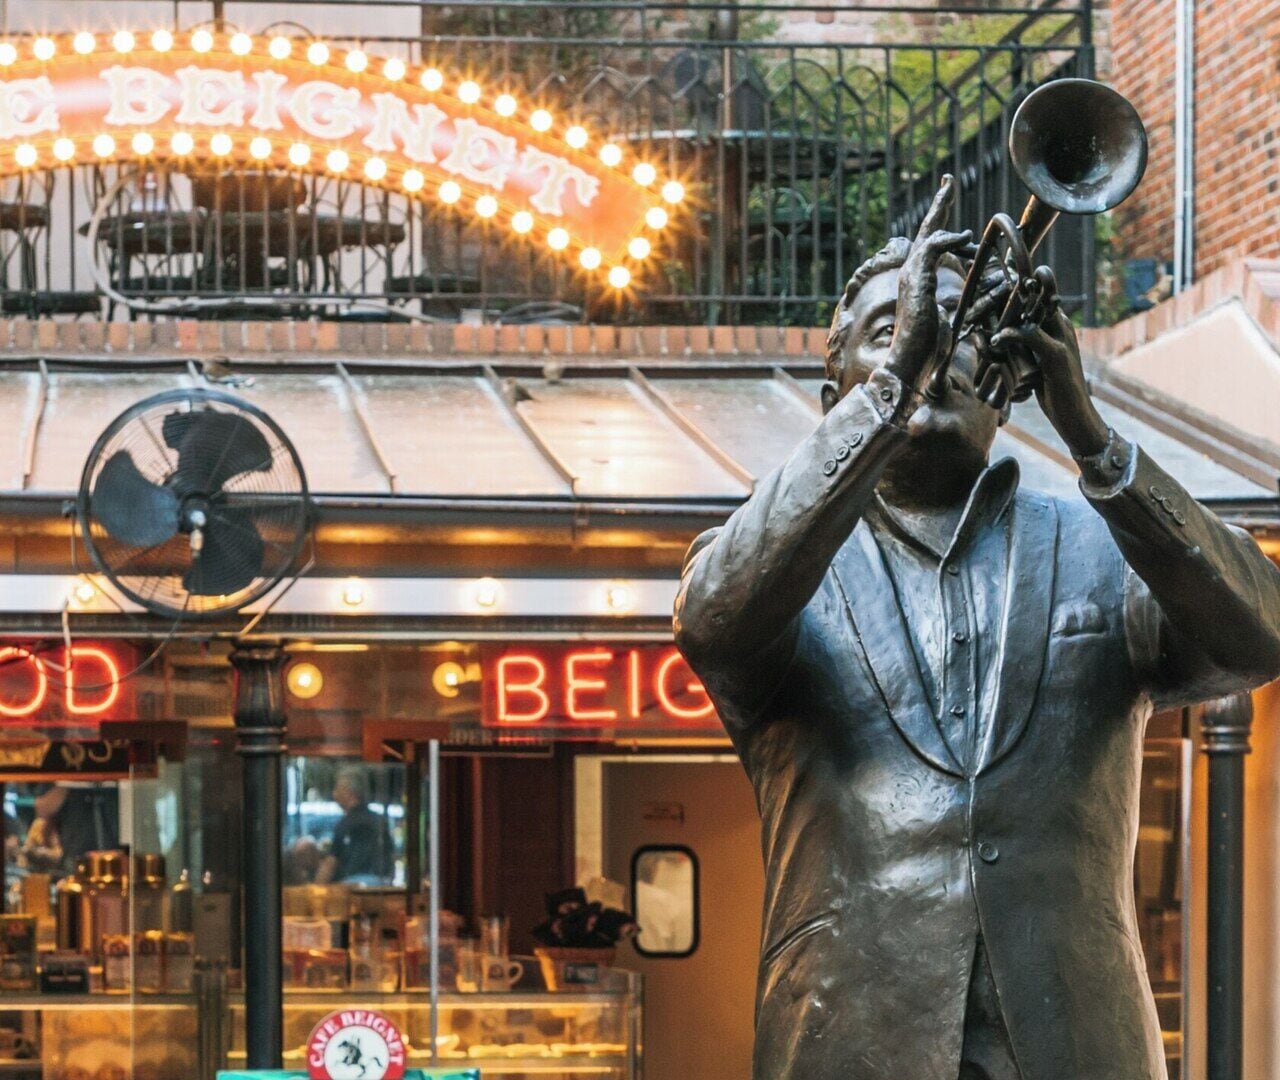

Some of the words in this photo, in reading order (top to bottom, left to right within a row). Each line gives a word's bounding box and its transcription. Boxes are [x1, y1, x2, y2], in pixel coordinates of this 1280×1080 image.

[98, 65, 601, 218] BEIGNET
[309, 1018, 341, 1068] CAFE
[339, 1010, 405, 1067] BEIGNET
